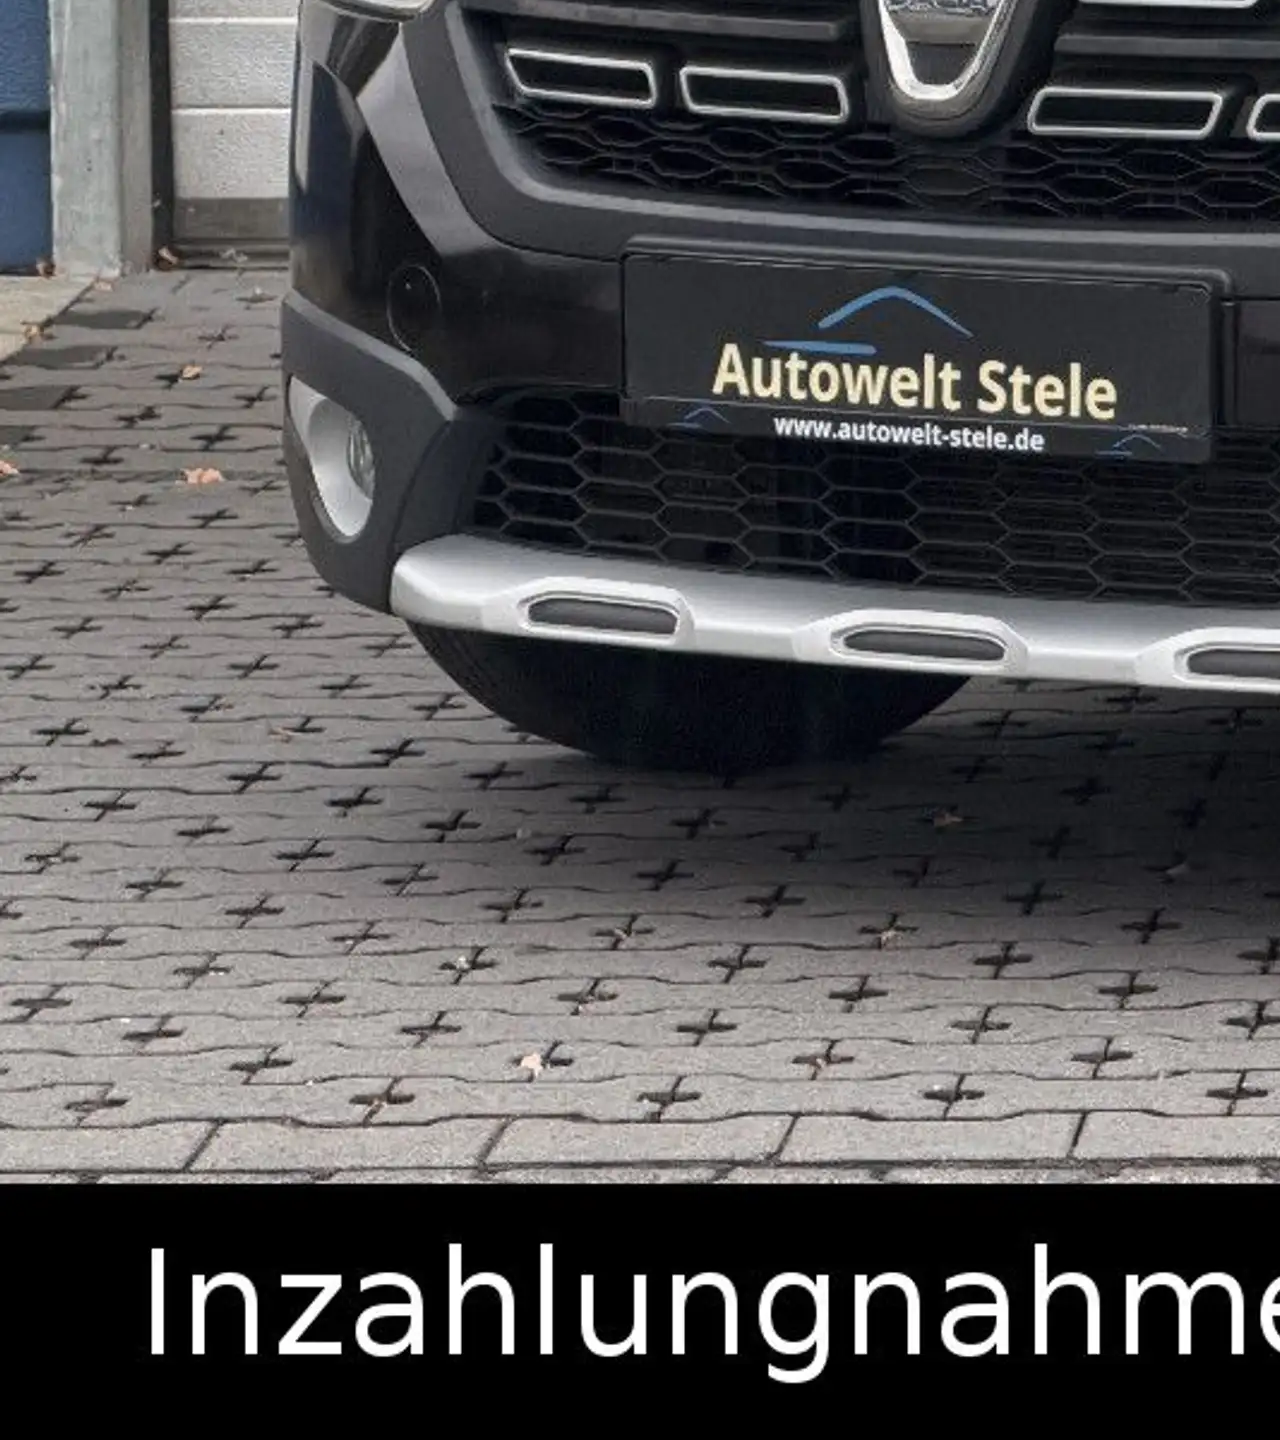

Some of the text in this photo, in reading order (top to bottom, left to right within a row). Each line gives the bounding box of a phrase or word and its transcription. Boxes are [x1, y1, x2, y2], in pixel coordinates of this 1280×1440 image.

[711, 342, 1118, 420] Autowelt Stele
[773, 416, 1046, 451] www.autowelt-stele.de
